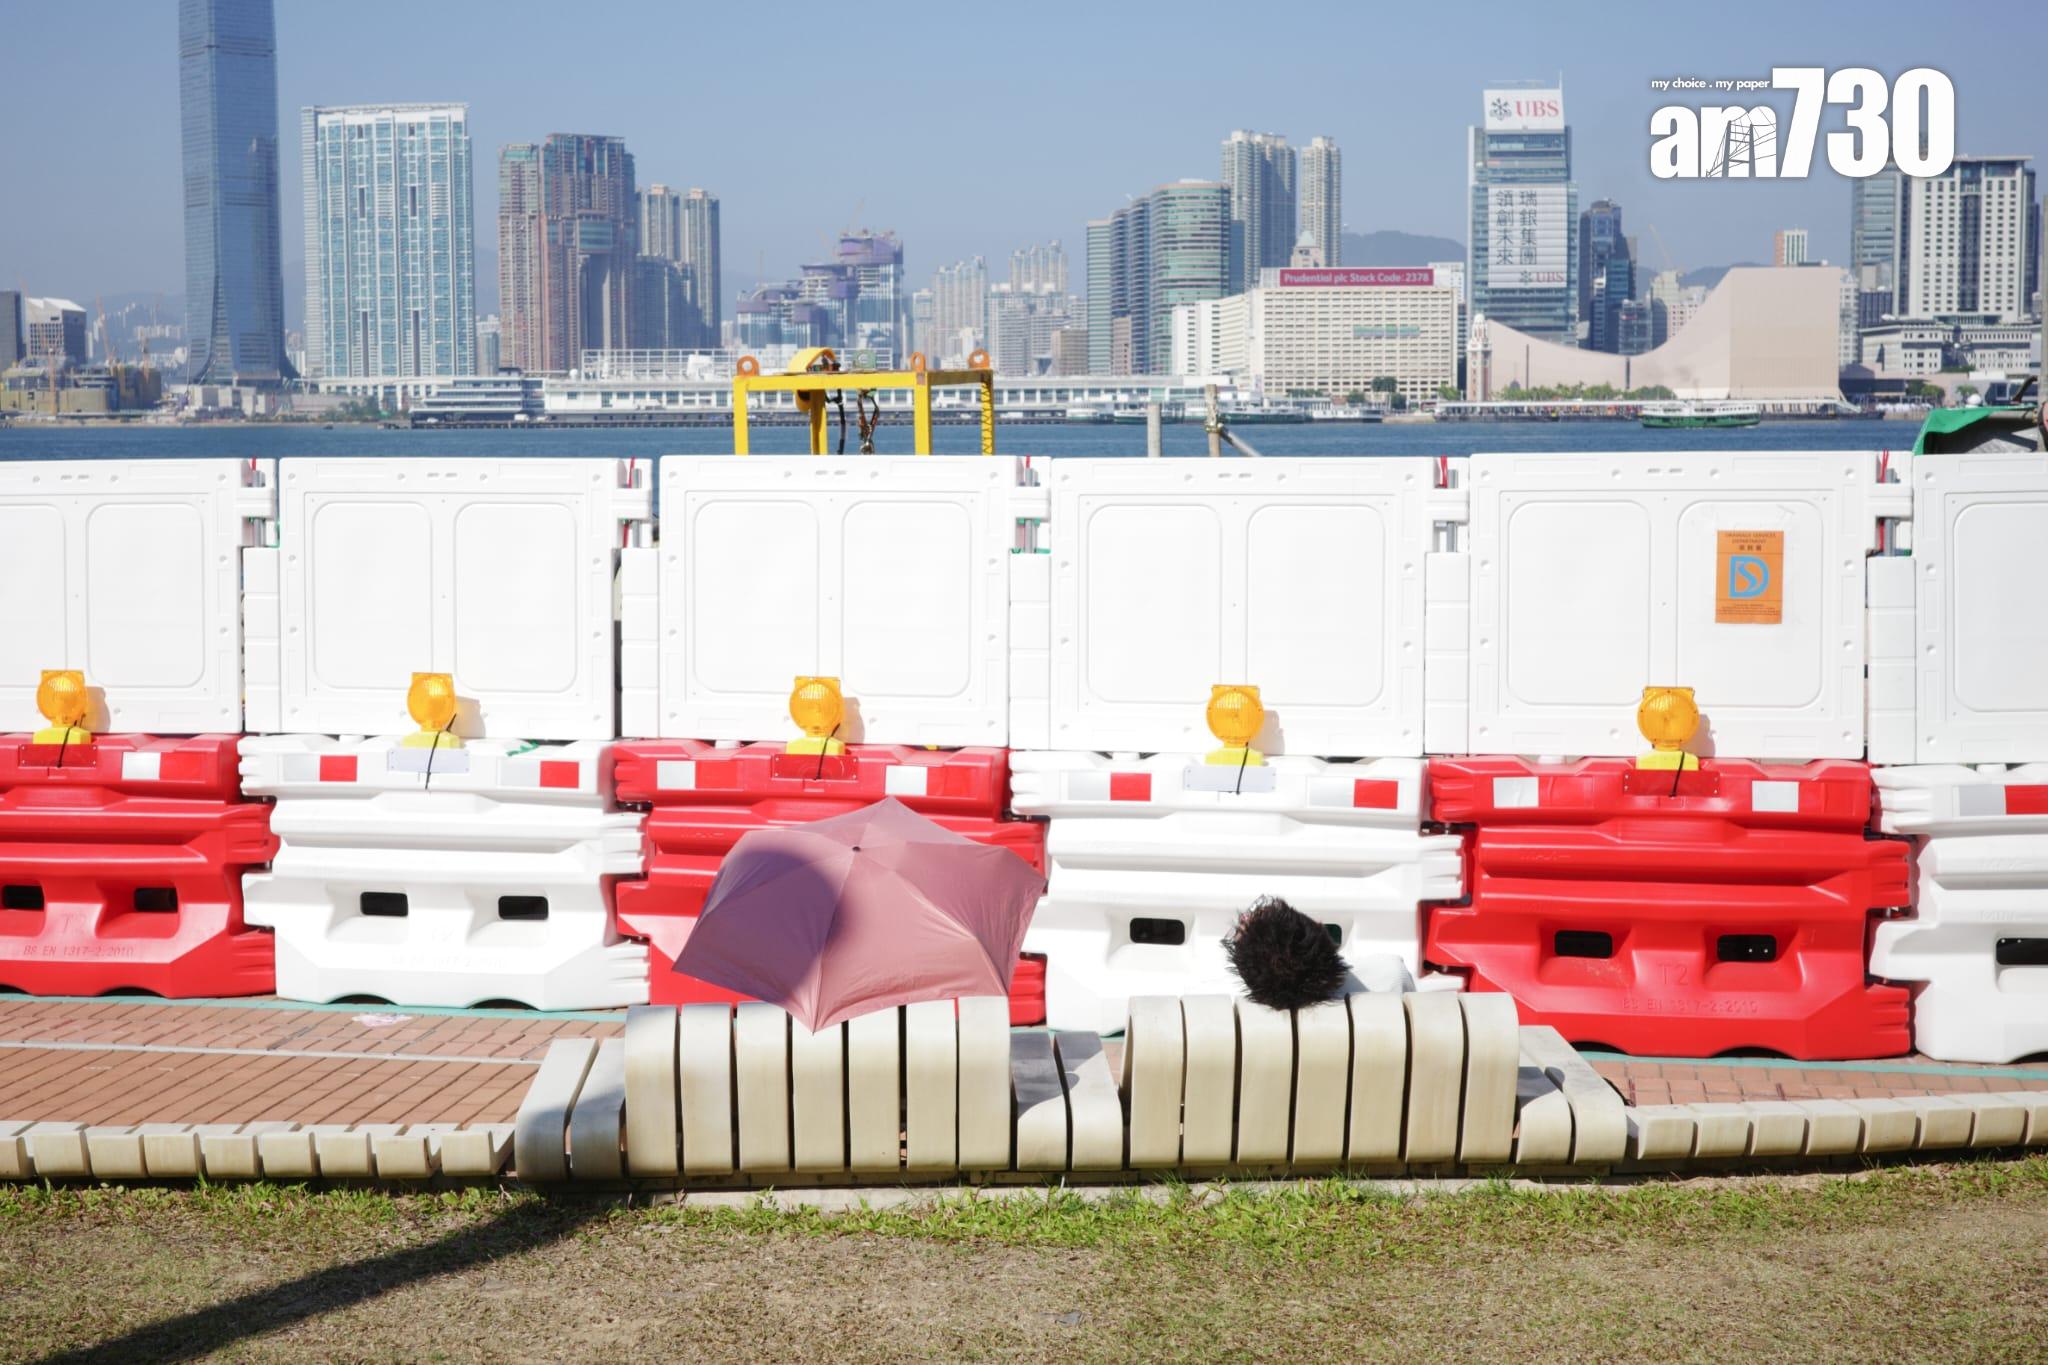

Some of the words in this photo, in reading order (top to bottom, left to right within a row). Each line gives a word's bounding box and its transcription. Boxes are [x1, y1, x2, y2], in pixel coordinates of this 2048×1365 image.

[1515, 100, 1559, 117] UBS
[1496, 190, 1513, 265] 領創未來
[1519, 190, 1537, 265] 瑞銀集團
[1284, 273, 1332, 282] Prudential
[1334, 273, 1347, 285] plc
[1350, 273, 1375, 282] Stock
[1535, 271, 1564, 283] UBS
[1658, 963, 1688, 986] T2
